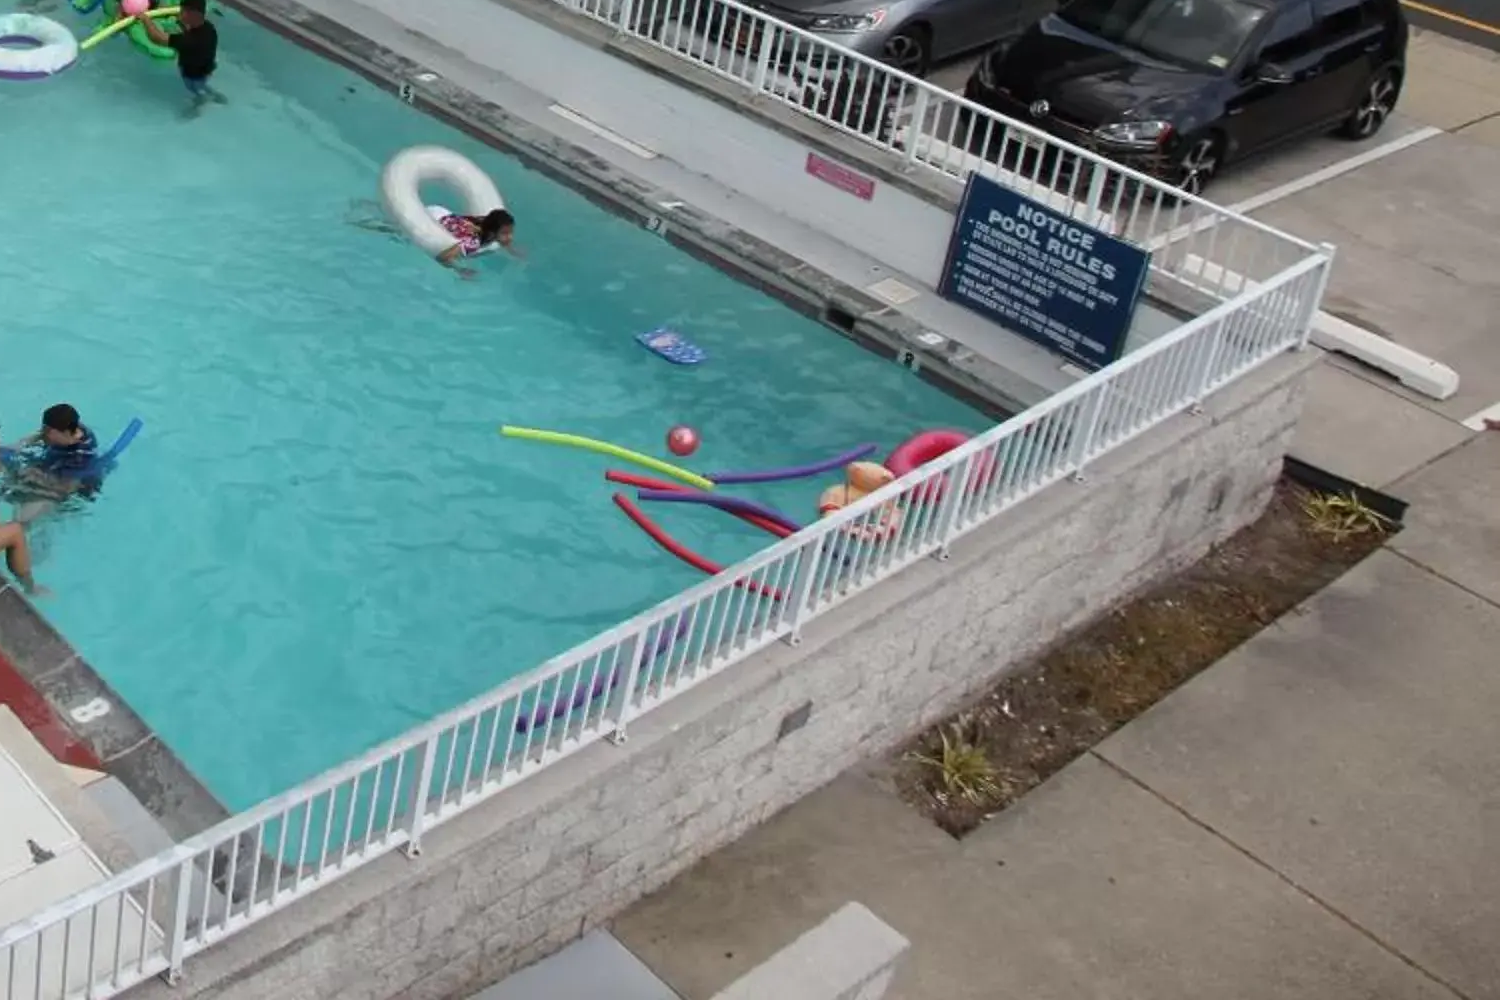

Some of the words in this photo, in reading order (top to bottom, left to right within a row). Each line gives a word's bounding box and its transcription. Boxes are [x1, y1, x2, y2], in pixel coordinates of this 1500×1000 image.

[988, 209, 1041, 246] POOL
[1046, 239, 1117, 281] RULES
[1017, 204, 1095, 250] NOTICE
[71, 697, 110, 722] 8
